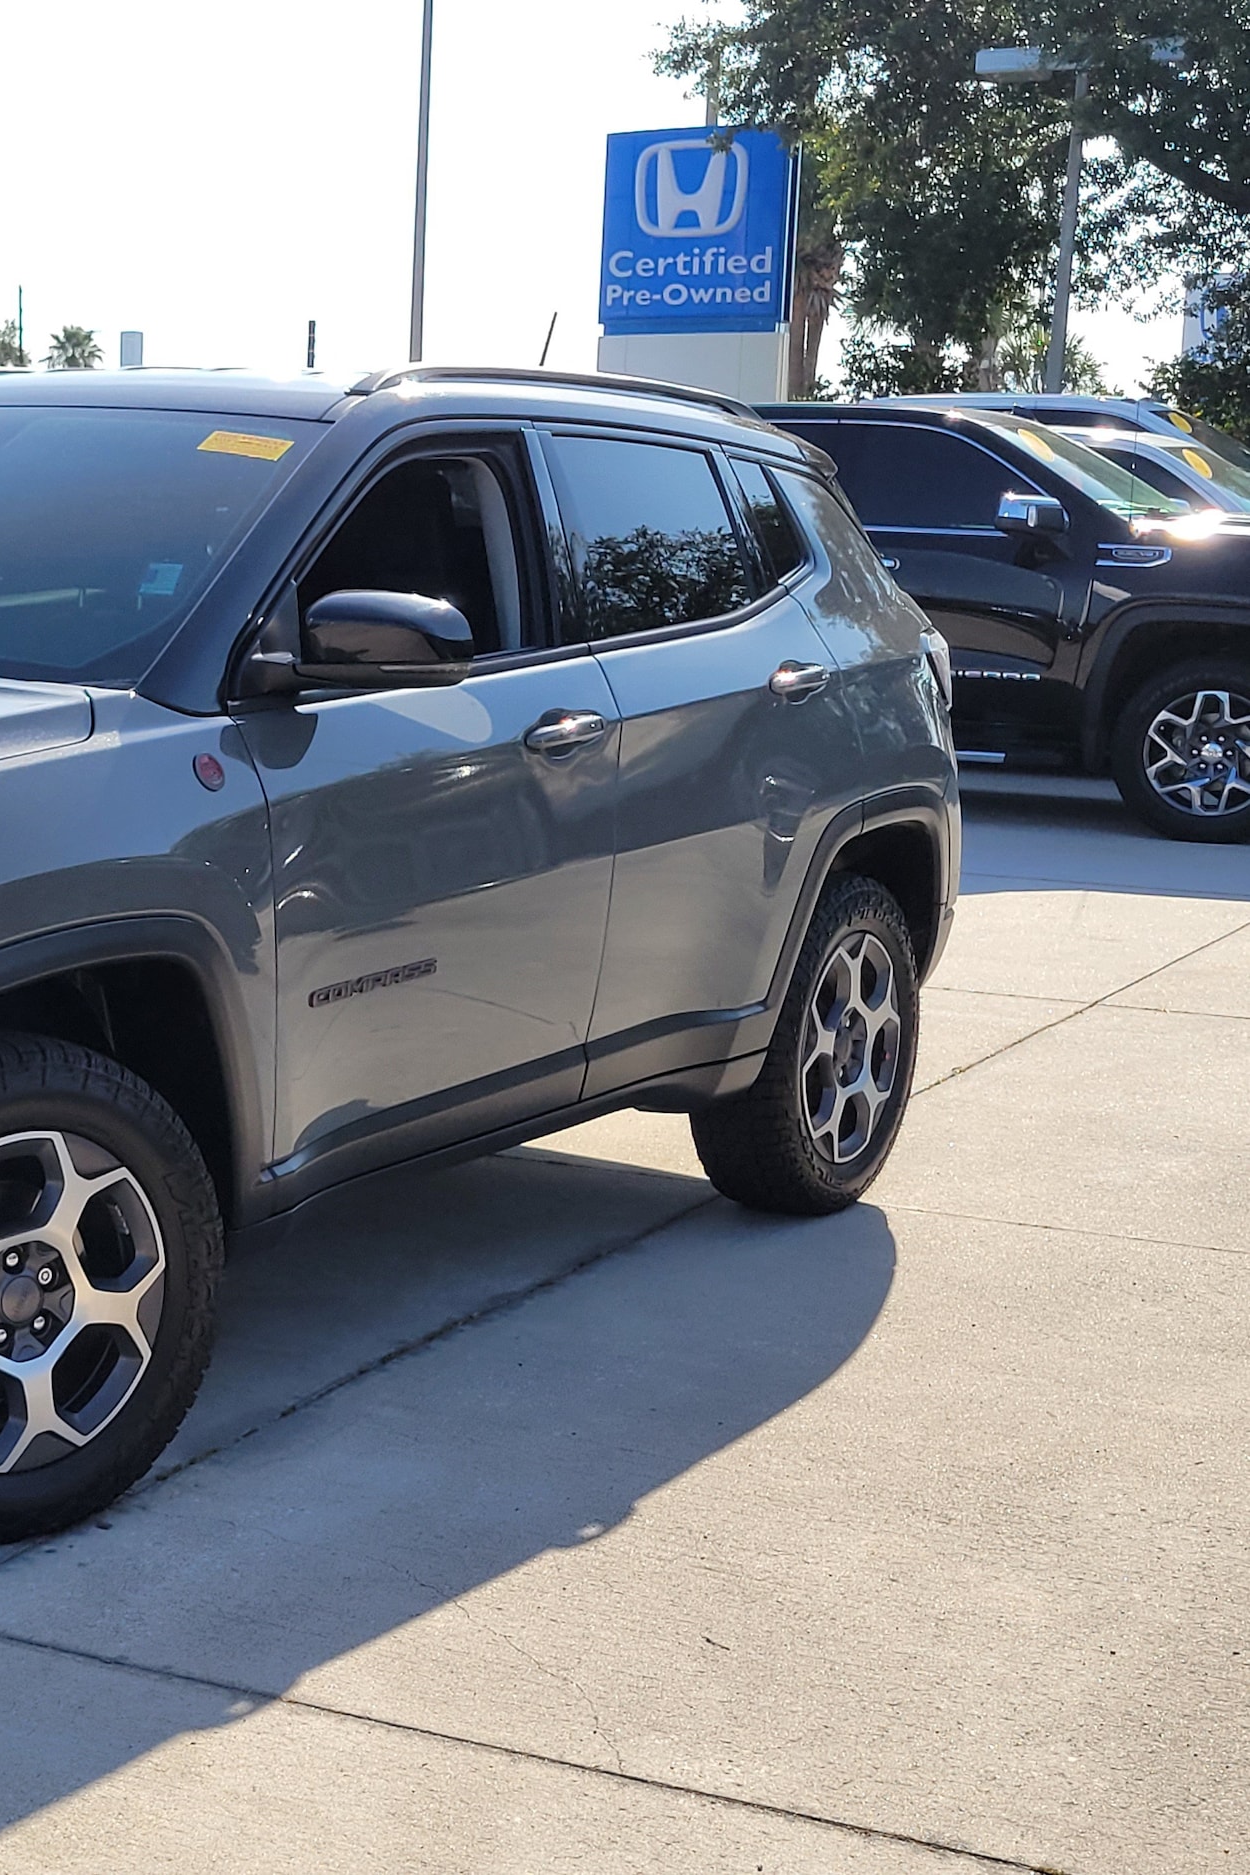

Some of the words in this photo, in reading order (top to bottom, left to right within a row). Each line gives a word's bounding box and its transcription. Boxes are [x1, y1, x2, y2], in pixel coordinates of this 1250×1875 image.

[608, 246, 773, 278] Certified
[606, 280, 771, 307] Pre-Owned
[308, 957, 438, 1008] COMPASS
